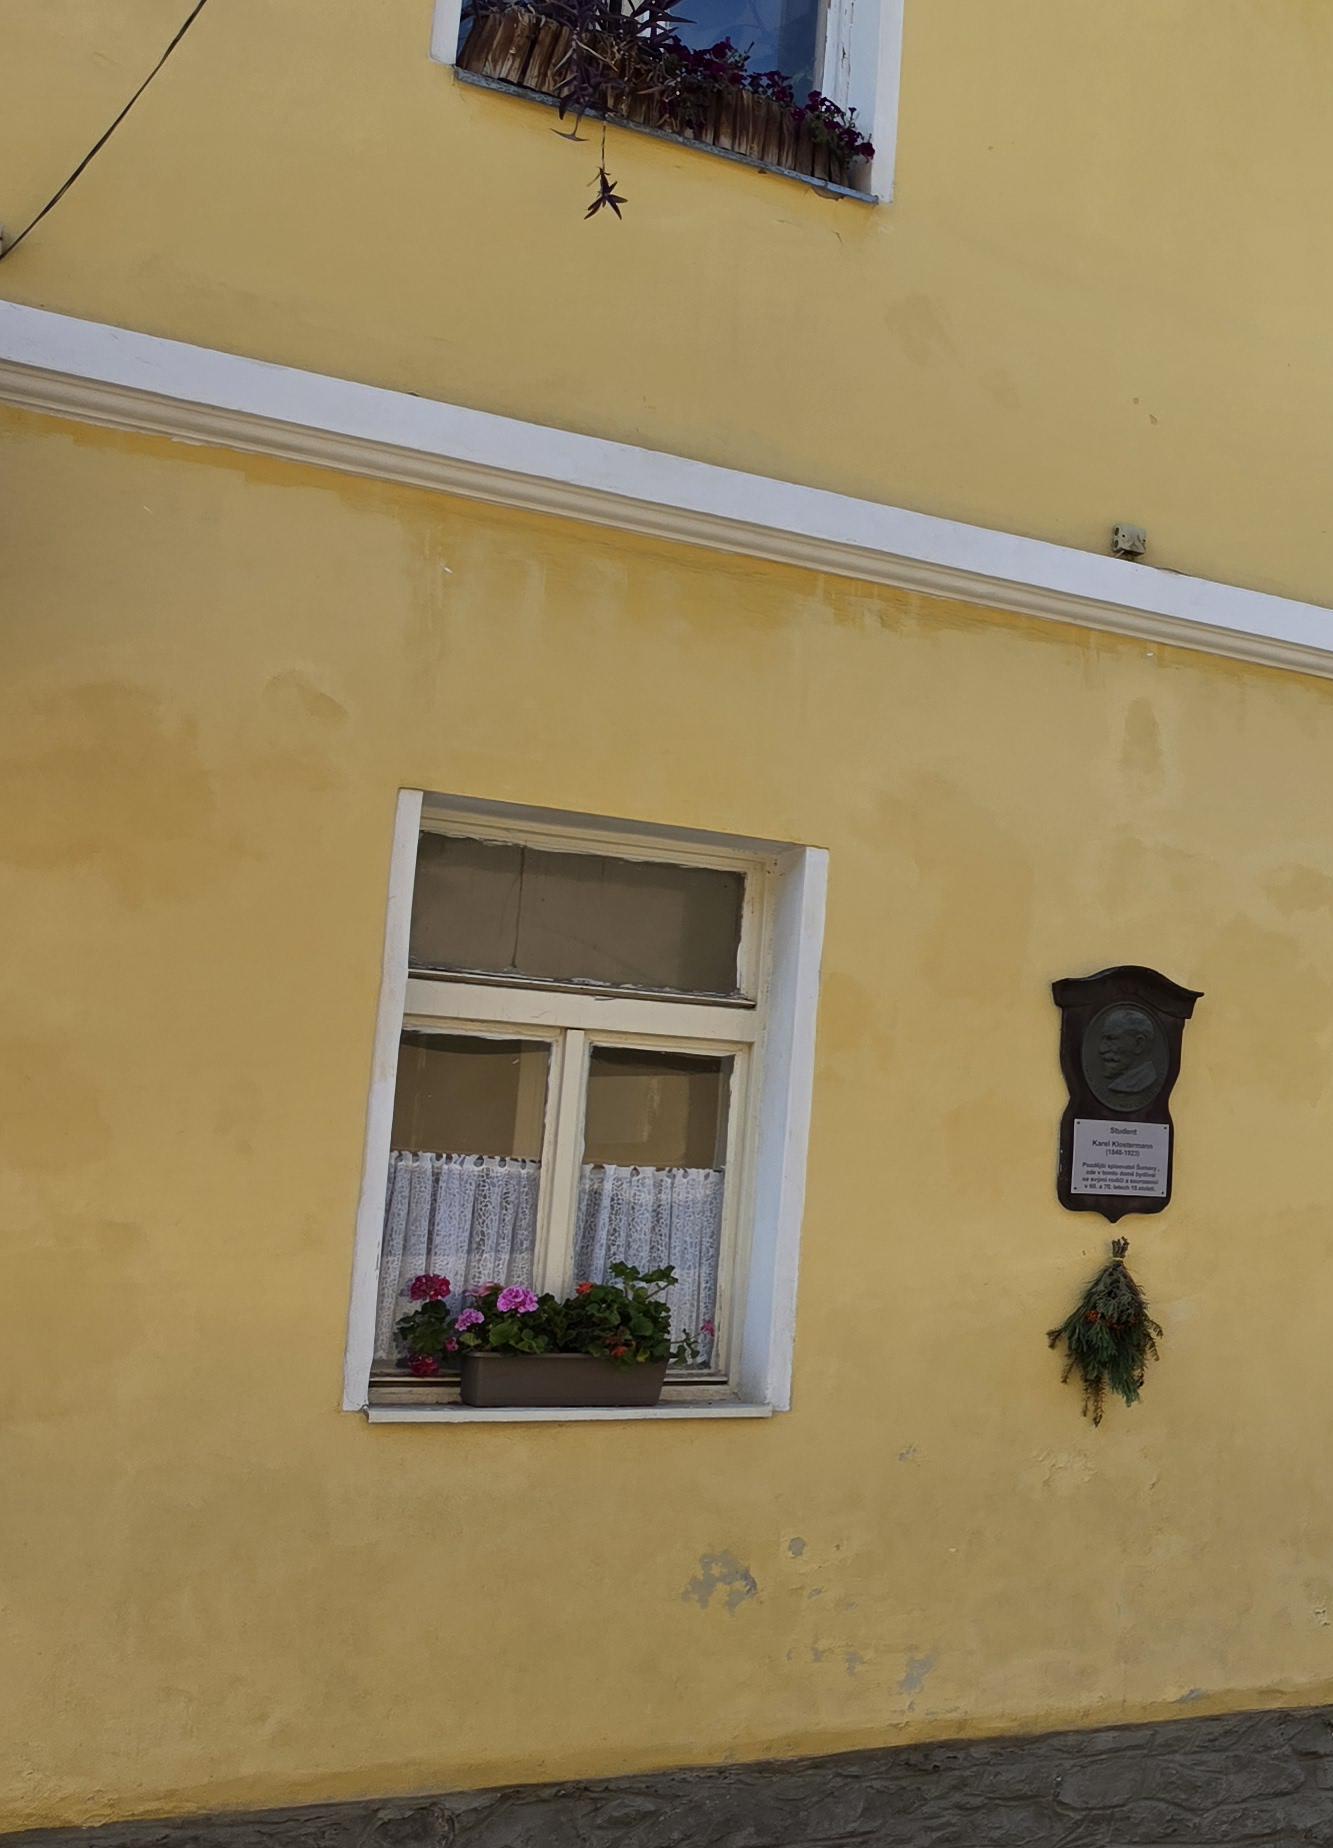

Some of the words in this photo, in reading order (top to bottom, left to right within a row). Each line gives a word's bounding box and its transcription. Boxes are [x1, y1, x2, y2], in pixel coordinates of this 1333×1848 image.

[1109, 1126, 1138, 1136] Student
[1091, 1139, 1111, 1148] Karel
[1111, 1140, 1154, 1150] Klostermann
